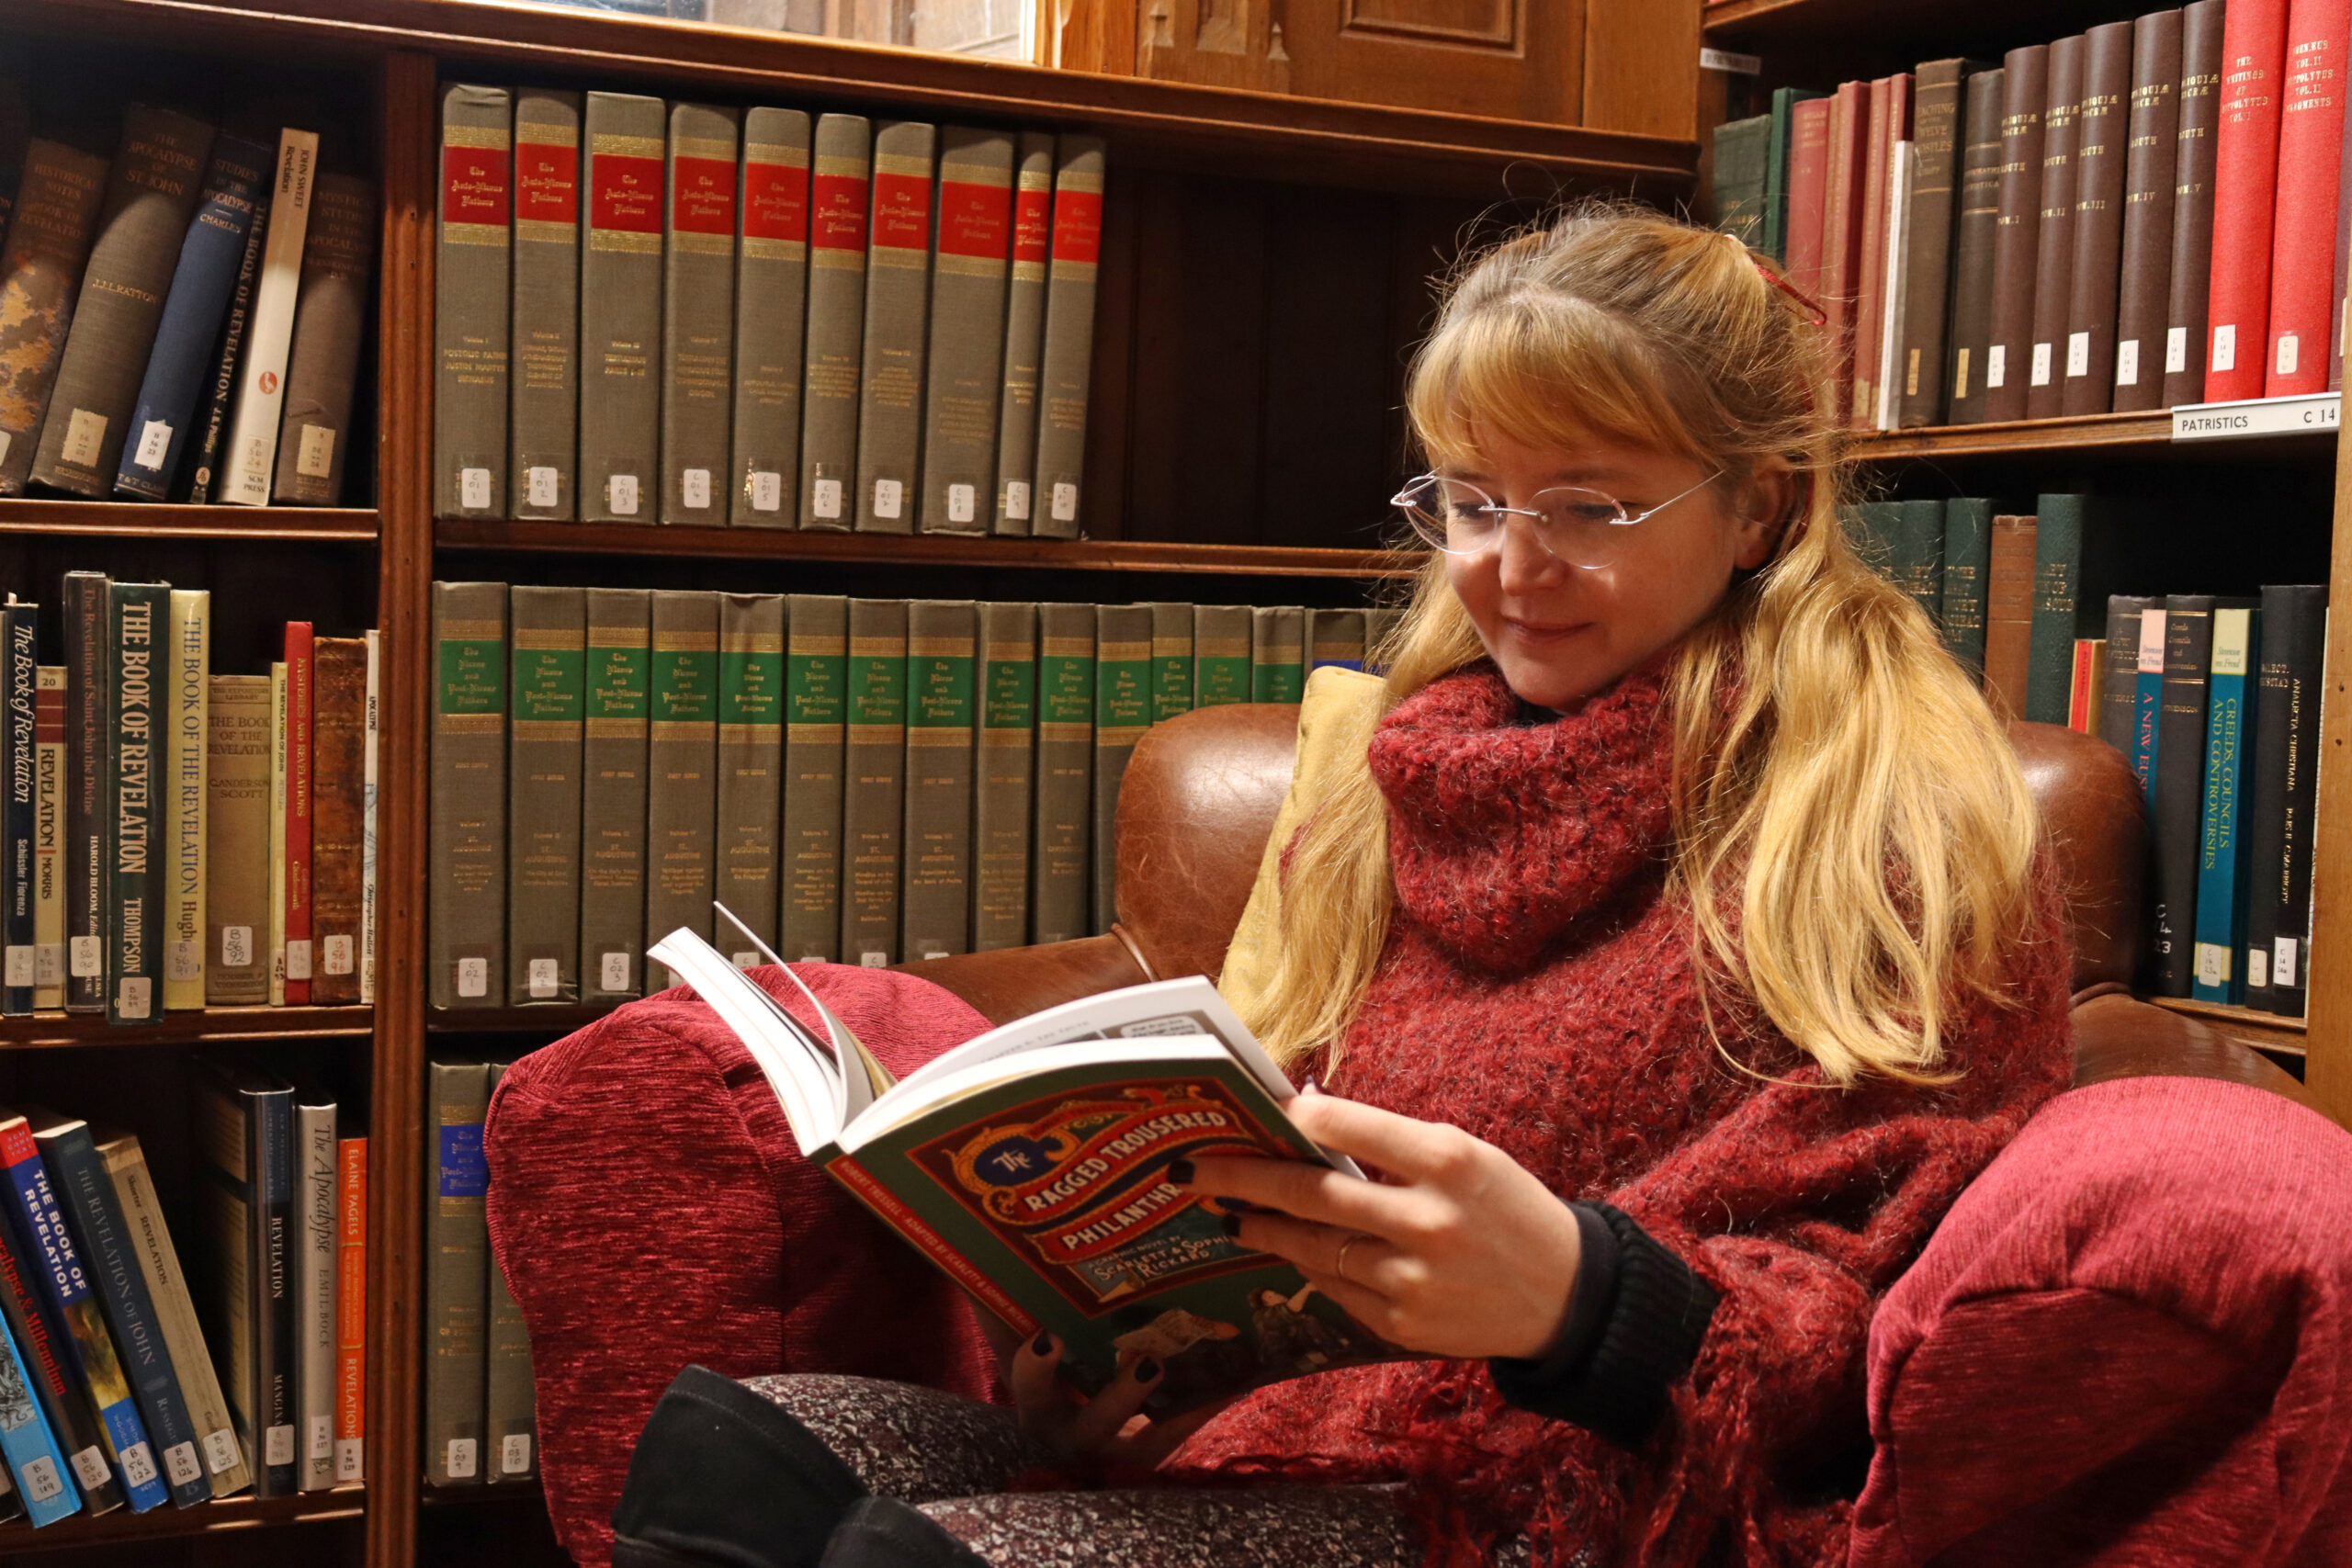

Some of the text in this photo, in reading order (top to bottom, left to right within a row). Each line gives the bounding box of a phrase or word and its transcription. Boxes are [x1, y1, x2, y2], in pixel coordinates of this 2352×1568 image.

[281, 145, 295, 194] Revelation
[216, 309, 244, 401] REVELATION
[2182, 407, 2335, 432] PATRISTICS C 14
[10, 625, 35, 803] The Book of Revelation
[41, 677, 56, 686] 20
[119, 602, 152, 874] THE BOOK OF REVELATION
[180, 618, 201, 895] THE BOOK OF THE REVELATION
[210, 717, 234, 728] THE
[220, 731, 262, 741] OF THE
[2139, 692, 2154, 791] A NEW EUS
[40, 748, 56, 847] REVELATION
[220, 790, 264, 799] SCOTT
[2205, 697, 2223, 871] AND CONTROVERSIES
[2219, 767, 2233, 849] COUNCILS
[41, 857, 51, 899] MORRIS
[90, 835, 99, 875] HAROLD
[17, 880, 28, 916] Fiorenza
[123, 897, 142, 974] THOMPSON
[231, 930, 242, 940] B
[2156, 904, 2166, 919] C
[230, 952, 245, 964] 92
[309, 1125, 335, 1253] The Apocalypse
[347, 1148, 359, 1235] ELAINE PAGELS
[992, 1148, 1032, 1173] The
[1024, 1111, 1227, 1212] RAGGED TROUSERED
[25, 1189, 73, 1297] REVELATION
[34, 1169, 87, 1290] THE BOOK OF
[128, 1175, 169, 1285] Shorter REVELATION
[841, 1161, 869, 1190] ROBERT
[868, 1184, 901, 1216] TRESSELL
[905, 1216, 938, 1247] ADAPTED
[1061, 1182, 1183, 1250] PHILANTHR
[77, 1168, 154, 1365] THE REVELATION OF JOHN
[272, 1217, 284, 1299] REVELATION
[1095, 1235, 1229, 1281] SCARLETT & SOPHI
[1136, 1239, 1168, 1253] NOVEL
[1137, 1249, 1211, 1280] RICKARD
[318, 1269, 329, 1348] EMIL BOCK
